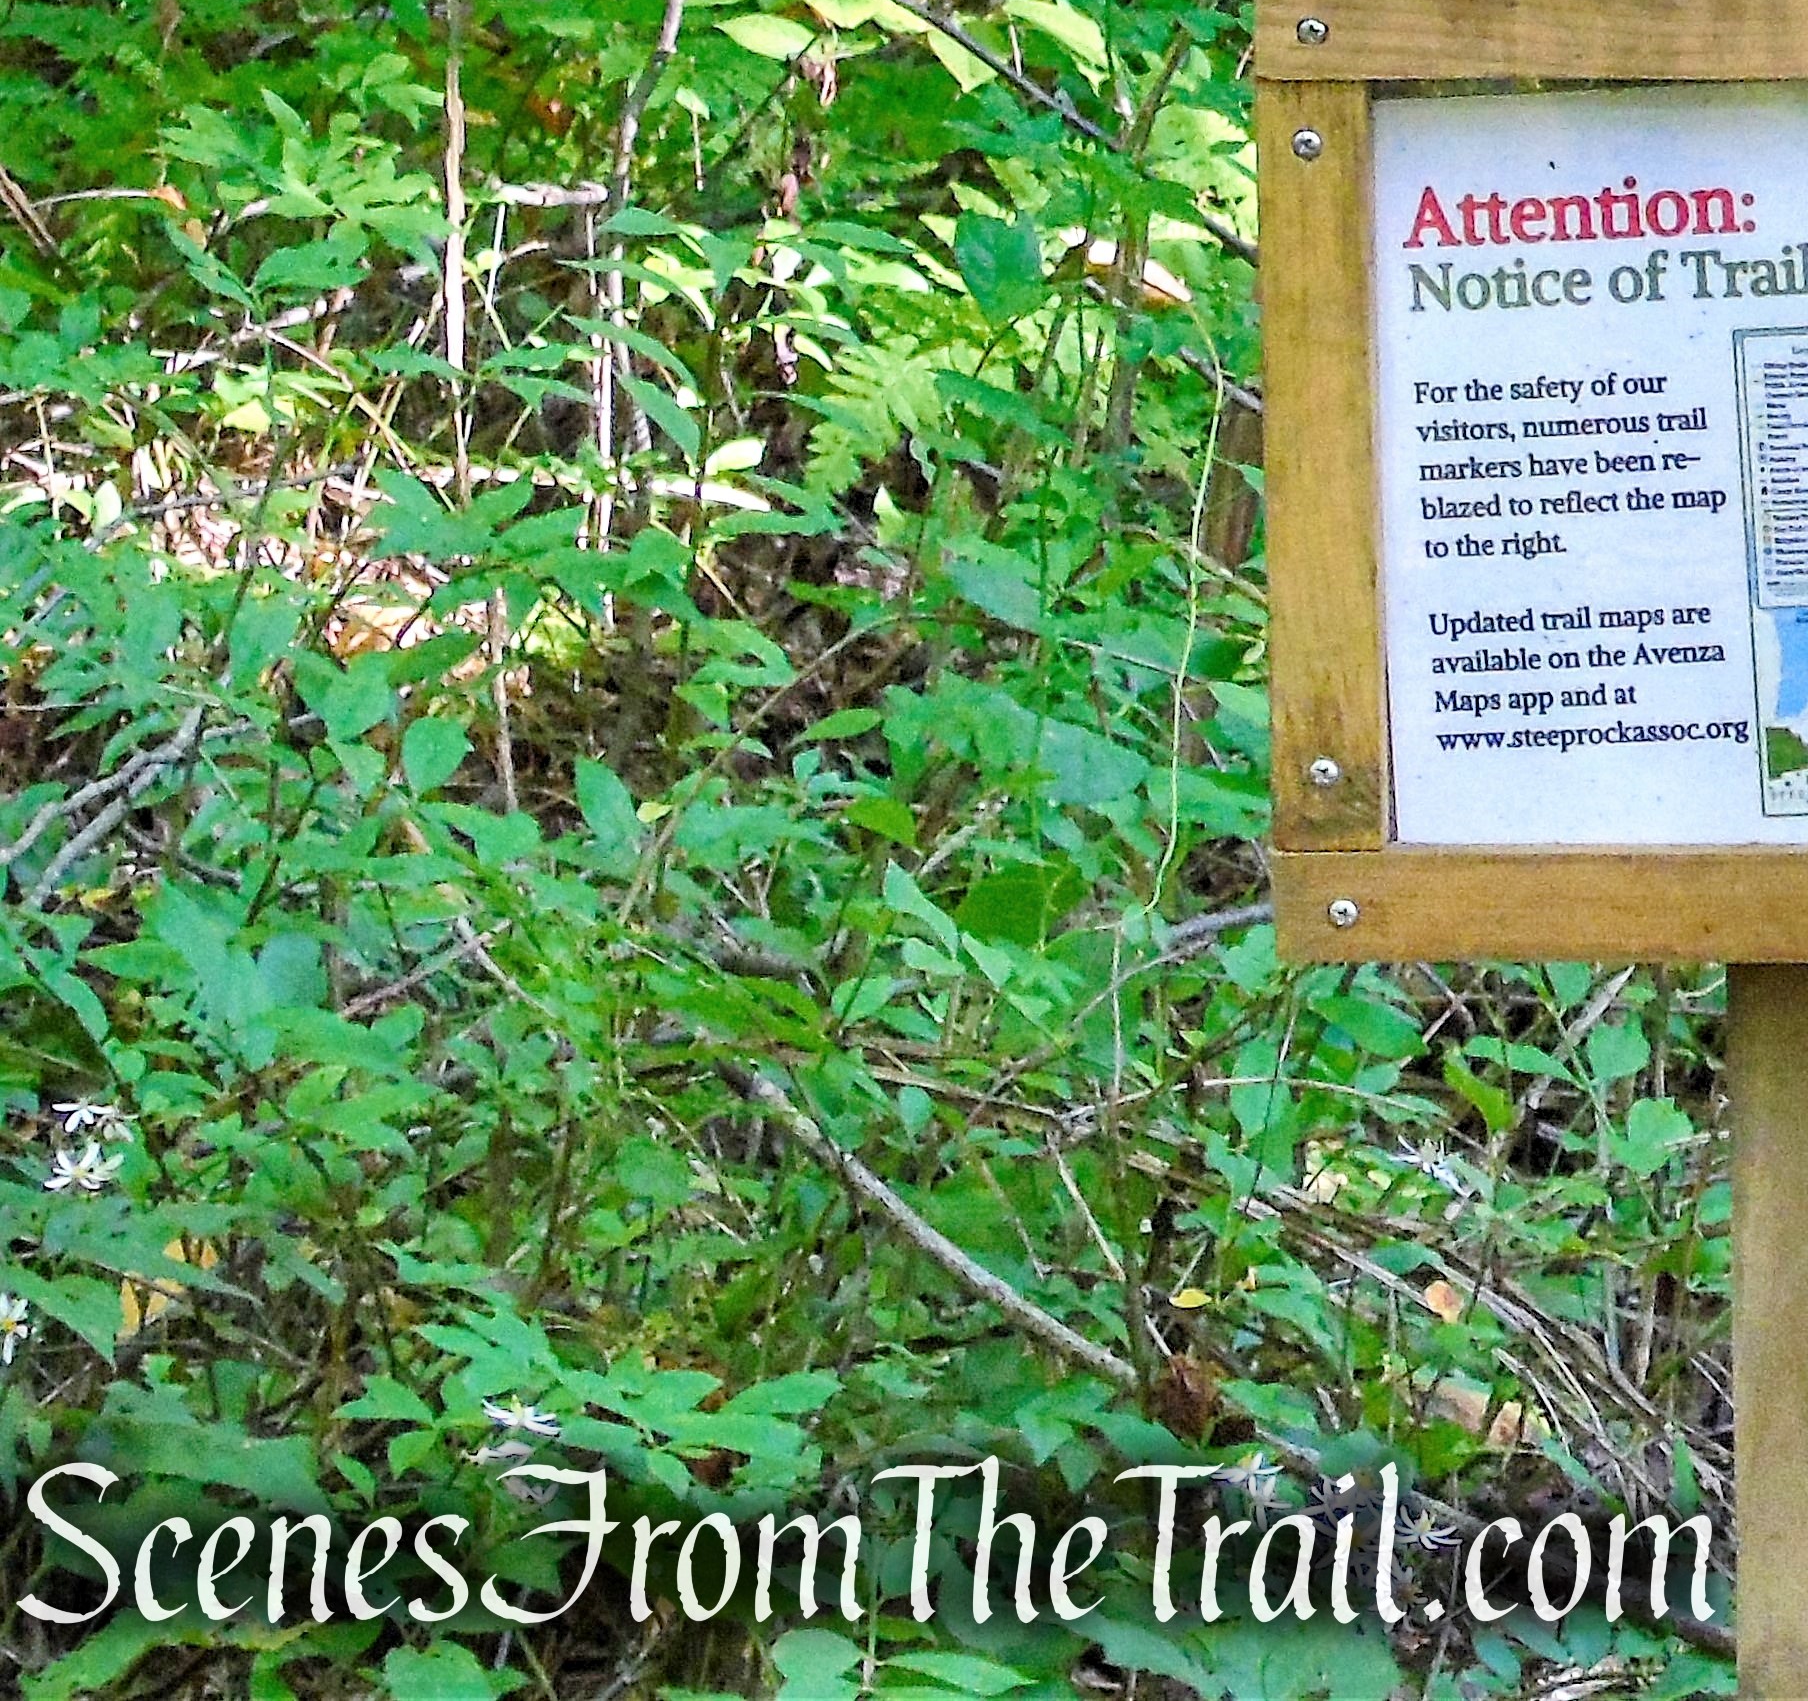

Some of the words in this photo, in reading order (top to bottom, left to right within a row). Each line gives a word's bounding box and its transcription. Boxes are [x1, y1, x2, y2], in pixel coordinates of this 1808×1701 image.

[1403, 175, 1756, 248] Attention:
[1408, 257, 1592, 312] Notice
[1608, 249, 1668, 303] of
[1414, 381, 1457, 404] For
[1464, 379, 1503, 401] the
[1510, 376, 1583, 403] safety
[1591, 372, 1617, 395] of
[1623, 375, 1667, 395] our
[1416, 419, 1515, 442] visitors,
[1523, 412, 1650, 437] numerous
[1657, 407, 1708, 430] trail
[1419, 456, 1523, 481] markers
[1529, 452, 1588, 476] have
[1595, 450, 1656, 473] been
[1662, 452, 1701, 471] re-
[1421, 493, 1502, 520] blazed
[1509, 497, 1533, 516] to
[1540, 490, 1620, 514] reflect
[1626, 487, 1665, 510] the
[1672, 489, 1727, 514] map
[1425, 539, 1449, 558] to
[1456, 533, 1495, 556] the
[1502, 530, 1567, 559] right.
[1429, 608, 1534, 641] Updated
[1541, 606, 1591, 630] trail
[1599, 607, 1665, 633] maps
[1672, 606, 1711, 624] are
[1432, 648, 1541, 674] available
[1548, 648, 1581, 668] on
[1588, 644, 1626, 667] the
[1633, 643, 1725, 665] Avenza
[1435, 690, 1501, 717] Maps
[1508, 693, 1554, 715] app
[1561, 683, 1607, 706] and
[1614, 685, 1637, 704] at
[1436, 720, 1749, 752] www.steeprockassoc.org
